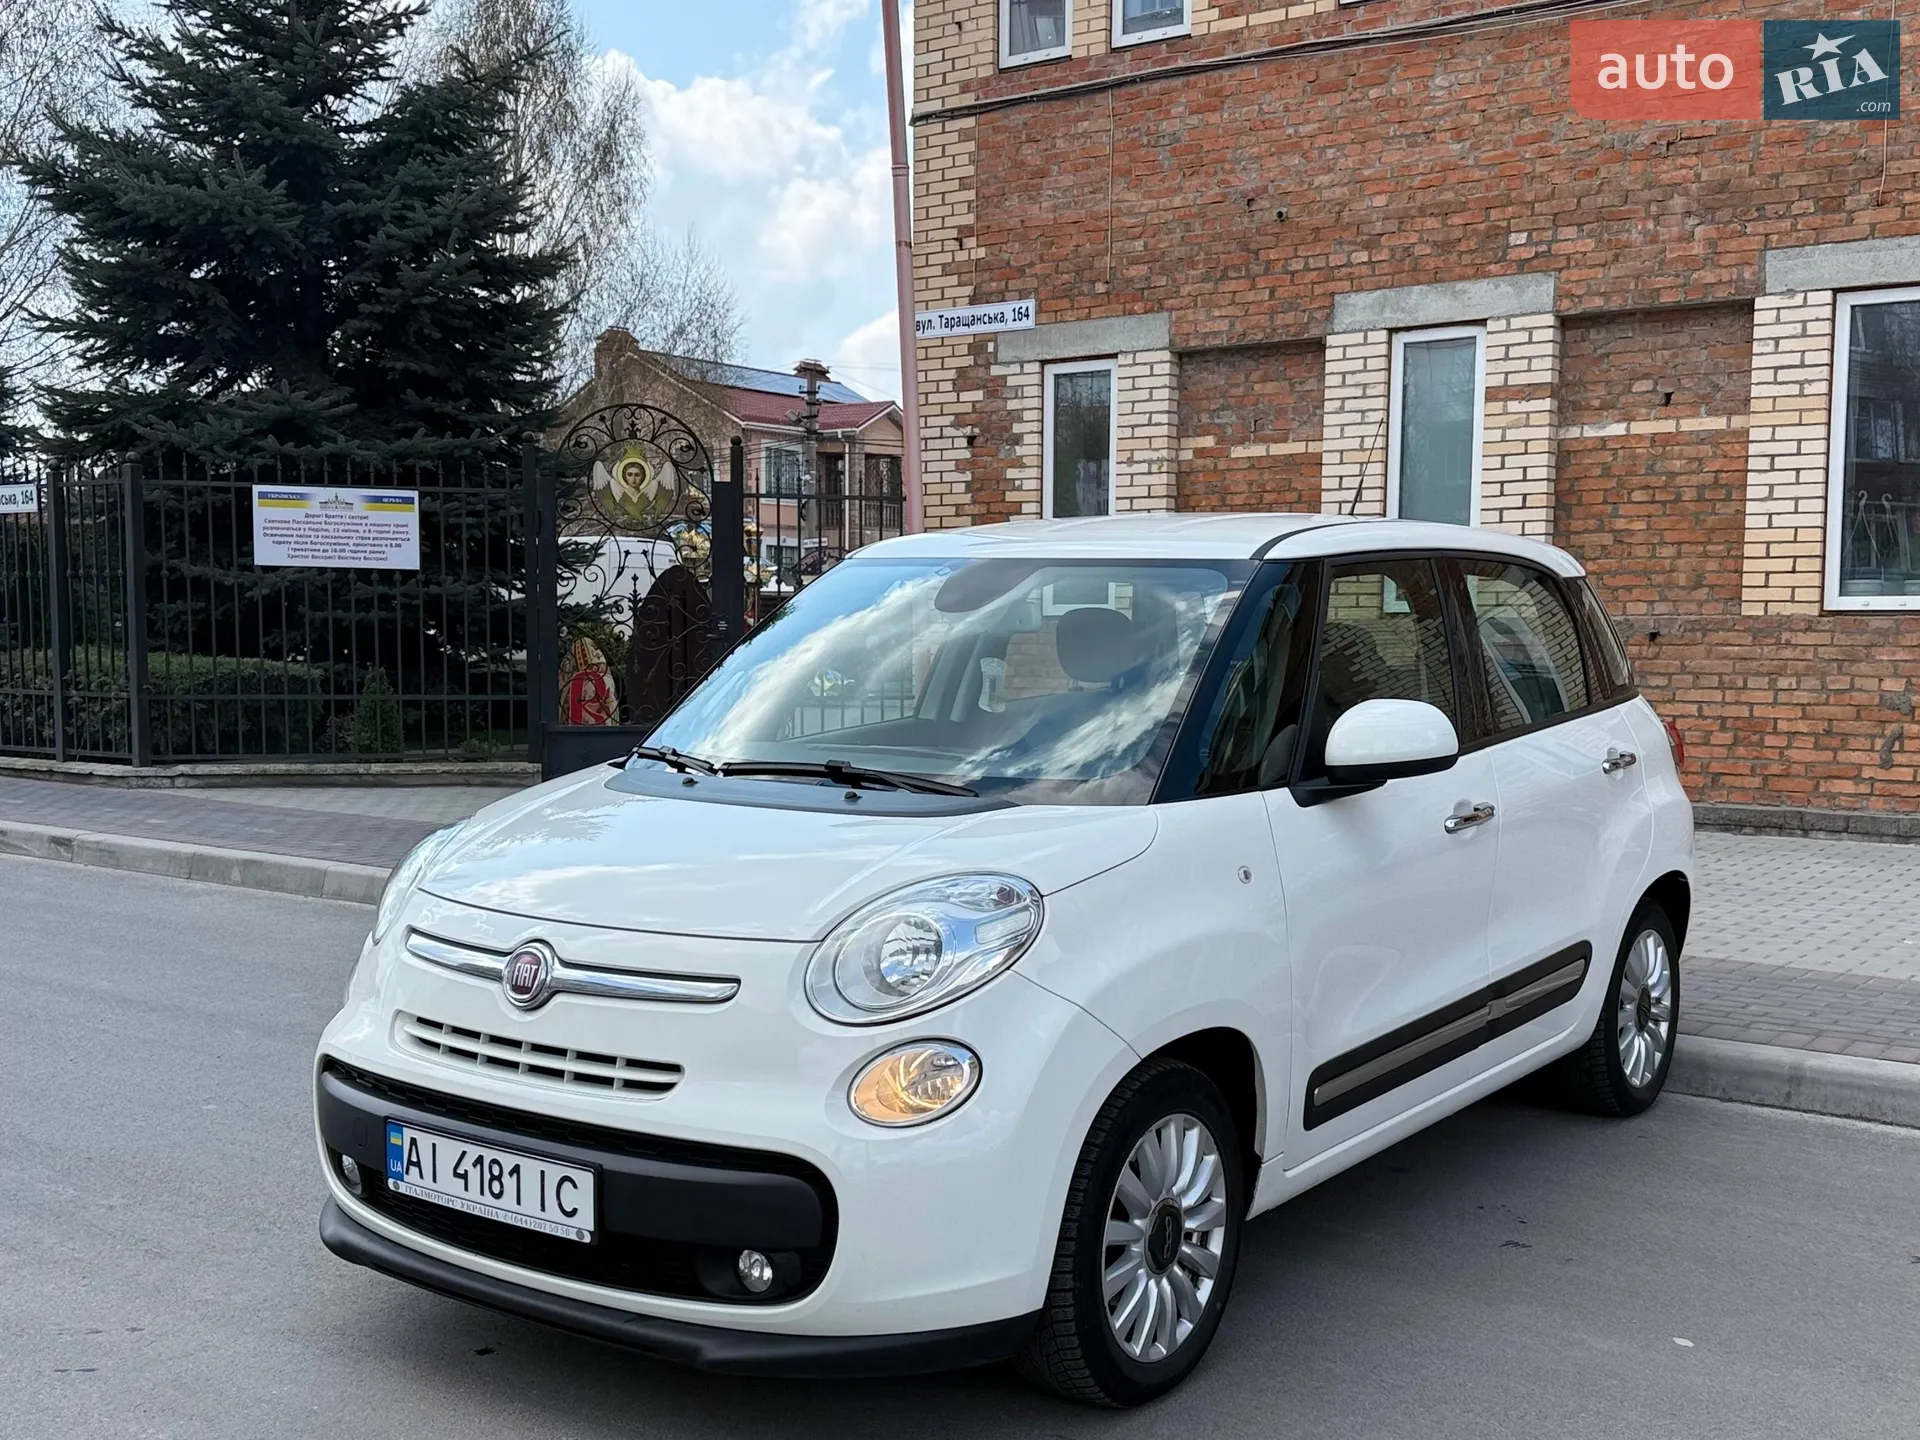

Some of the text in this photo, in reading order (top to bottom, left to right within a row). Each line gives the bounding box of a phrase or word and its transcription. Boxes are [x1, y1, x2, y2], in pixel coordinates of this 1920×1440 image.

[916, 305, 1030, 334] вул. Таращанська, 164
[0, 489, 34, 508] ська, 164
[512, 963, 538, 987] FIAT
[390, 1158, 403, 1174] UA
[405, 1136, 579, 1218] AI 4181 IC
[405, 1185, 458, 1207] ІТАЛМОТОРС
[460, 1201, 500, 1219] УКРАЇНА
